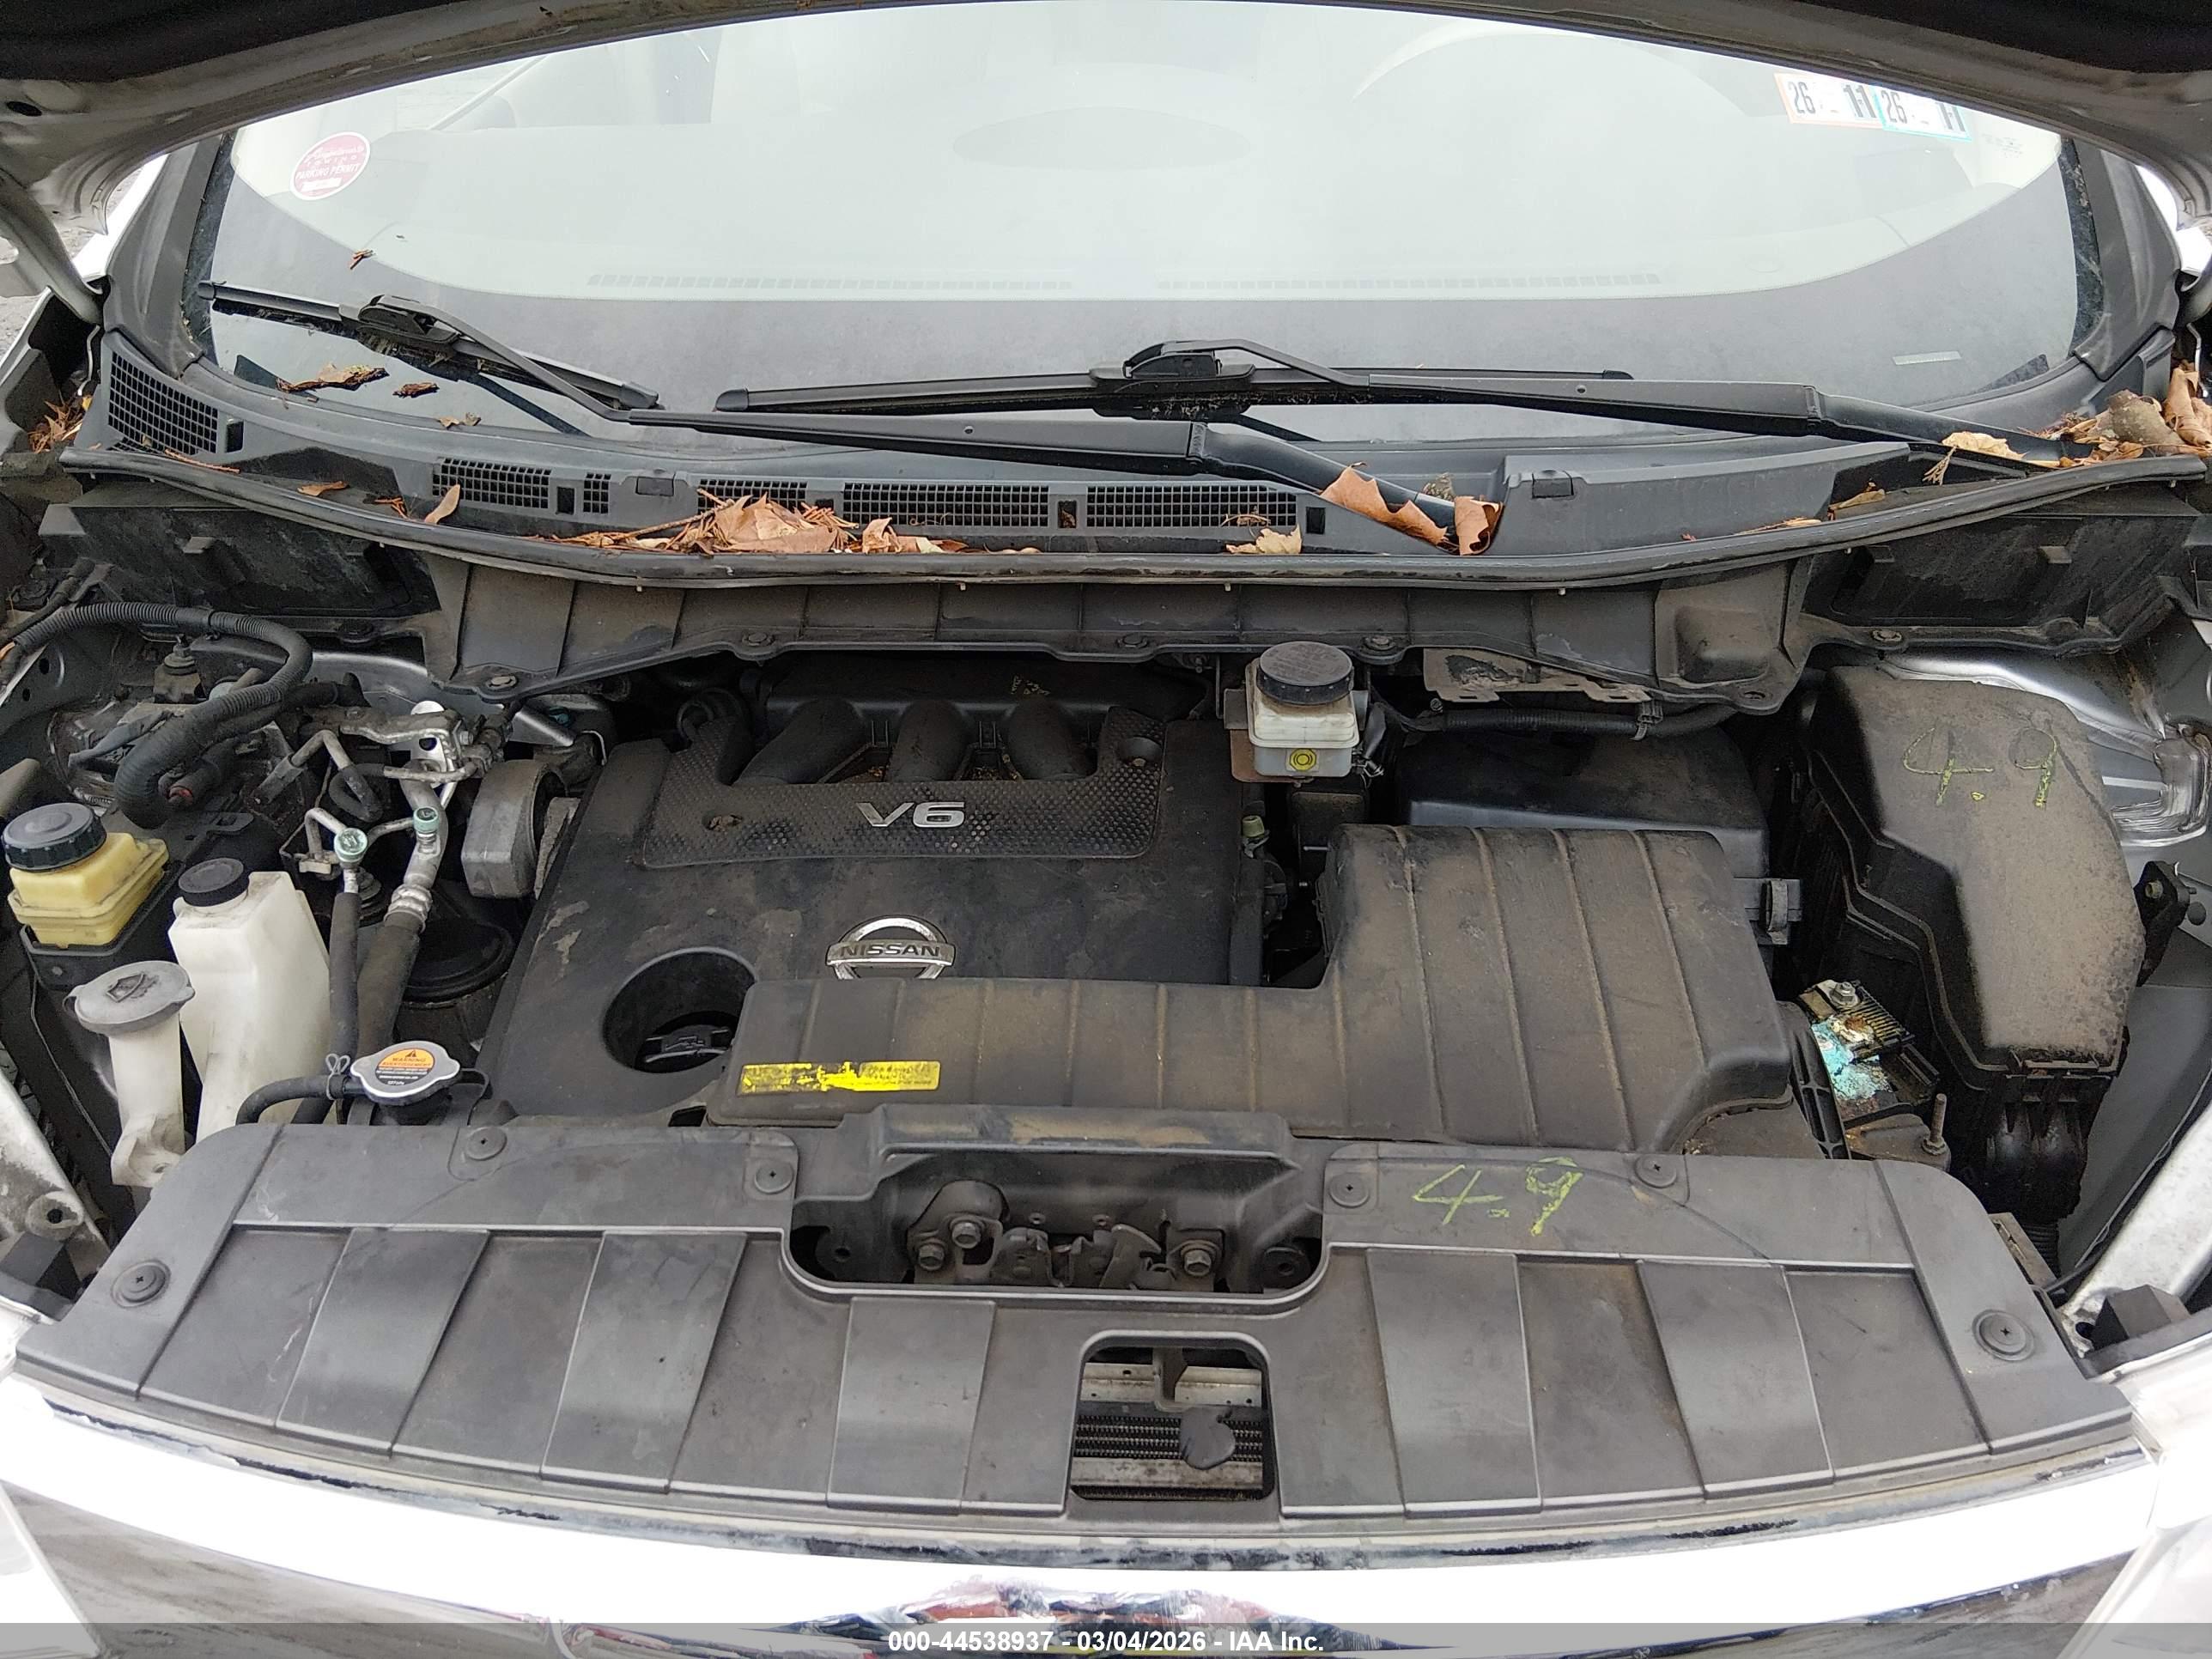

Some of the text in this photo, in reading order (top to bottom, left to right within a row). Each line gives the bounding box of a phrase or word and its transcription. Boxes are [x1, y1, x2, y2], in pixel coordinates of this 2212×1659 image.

[1788, 81, 1876, 118] 26 11
[1881, 89, 1908, 125] 26
[295, 166, 330, 179] PARKING
[856, 802, 965, 828] V6
[839, 944, 941, 957] NISSAN
[1411, 1157, 1584, 1237] 4.9
